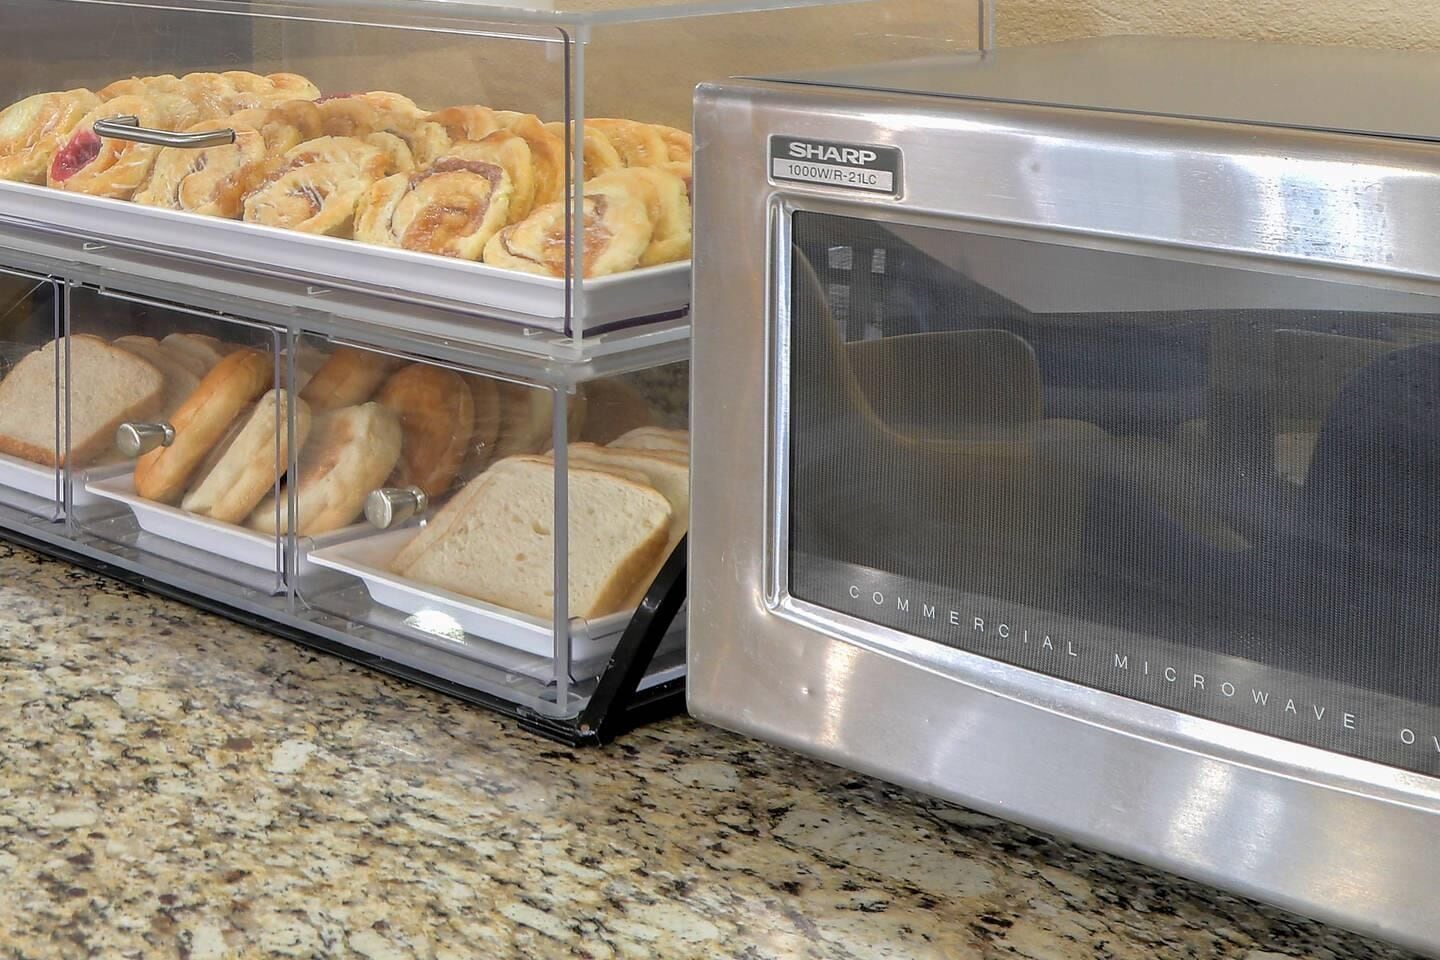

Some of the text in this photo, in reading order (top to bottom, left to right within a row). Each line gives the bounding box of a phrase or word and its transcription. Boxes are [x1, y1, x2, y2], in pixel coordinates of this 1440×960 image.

[789, 142, 877, 165] SHARP
[788, 164, 877, 185] 1000W/R-21LC
[848, 584, 1079, 658] COMMERCIAL
[1114, 653, 1357, 730] MICROWAVE
